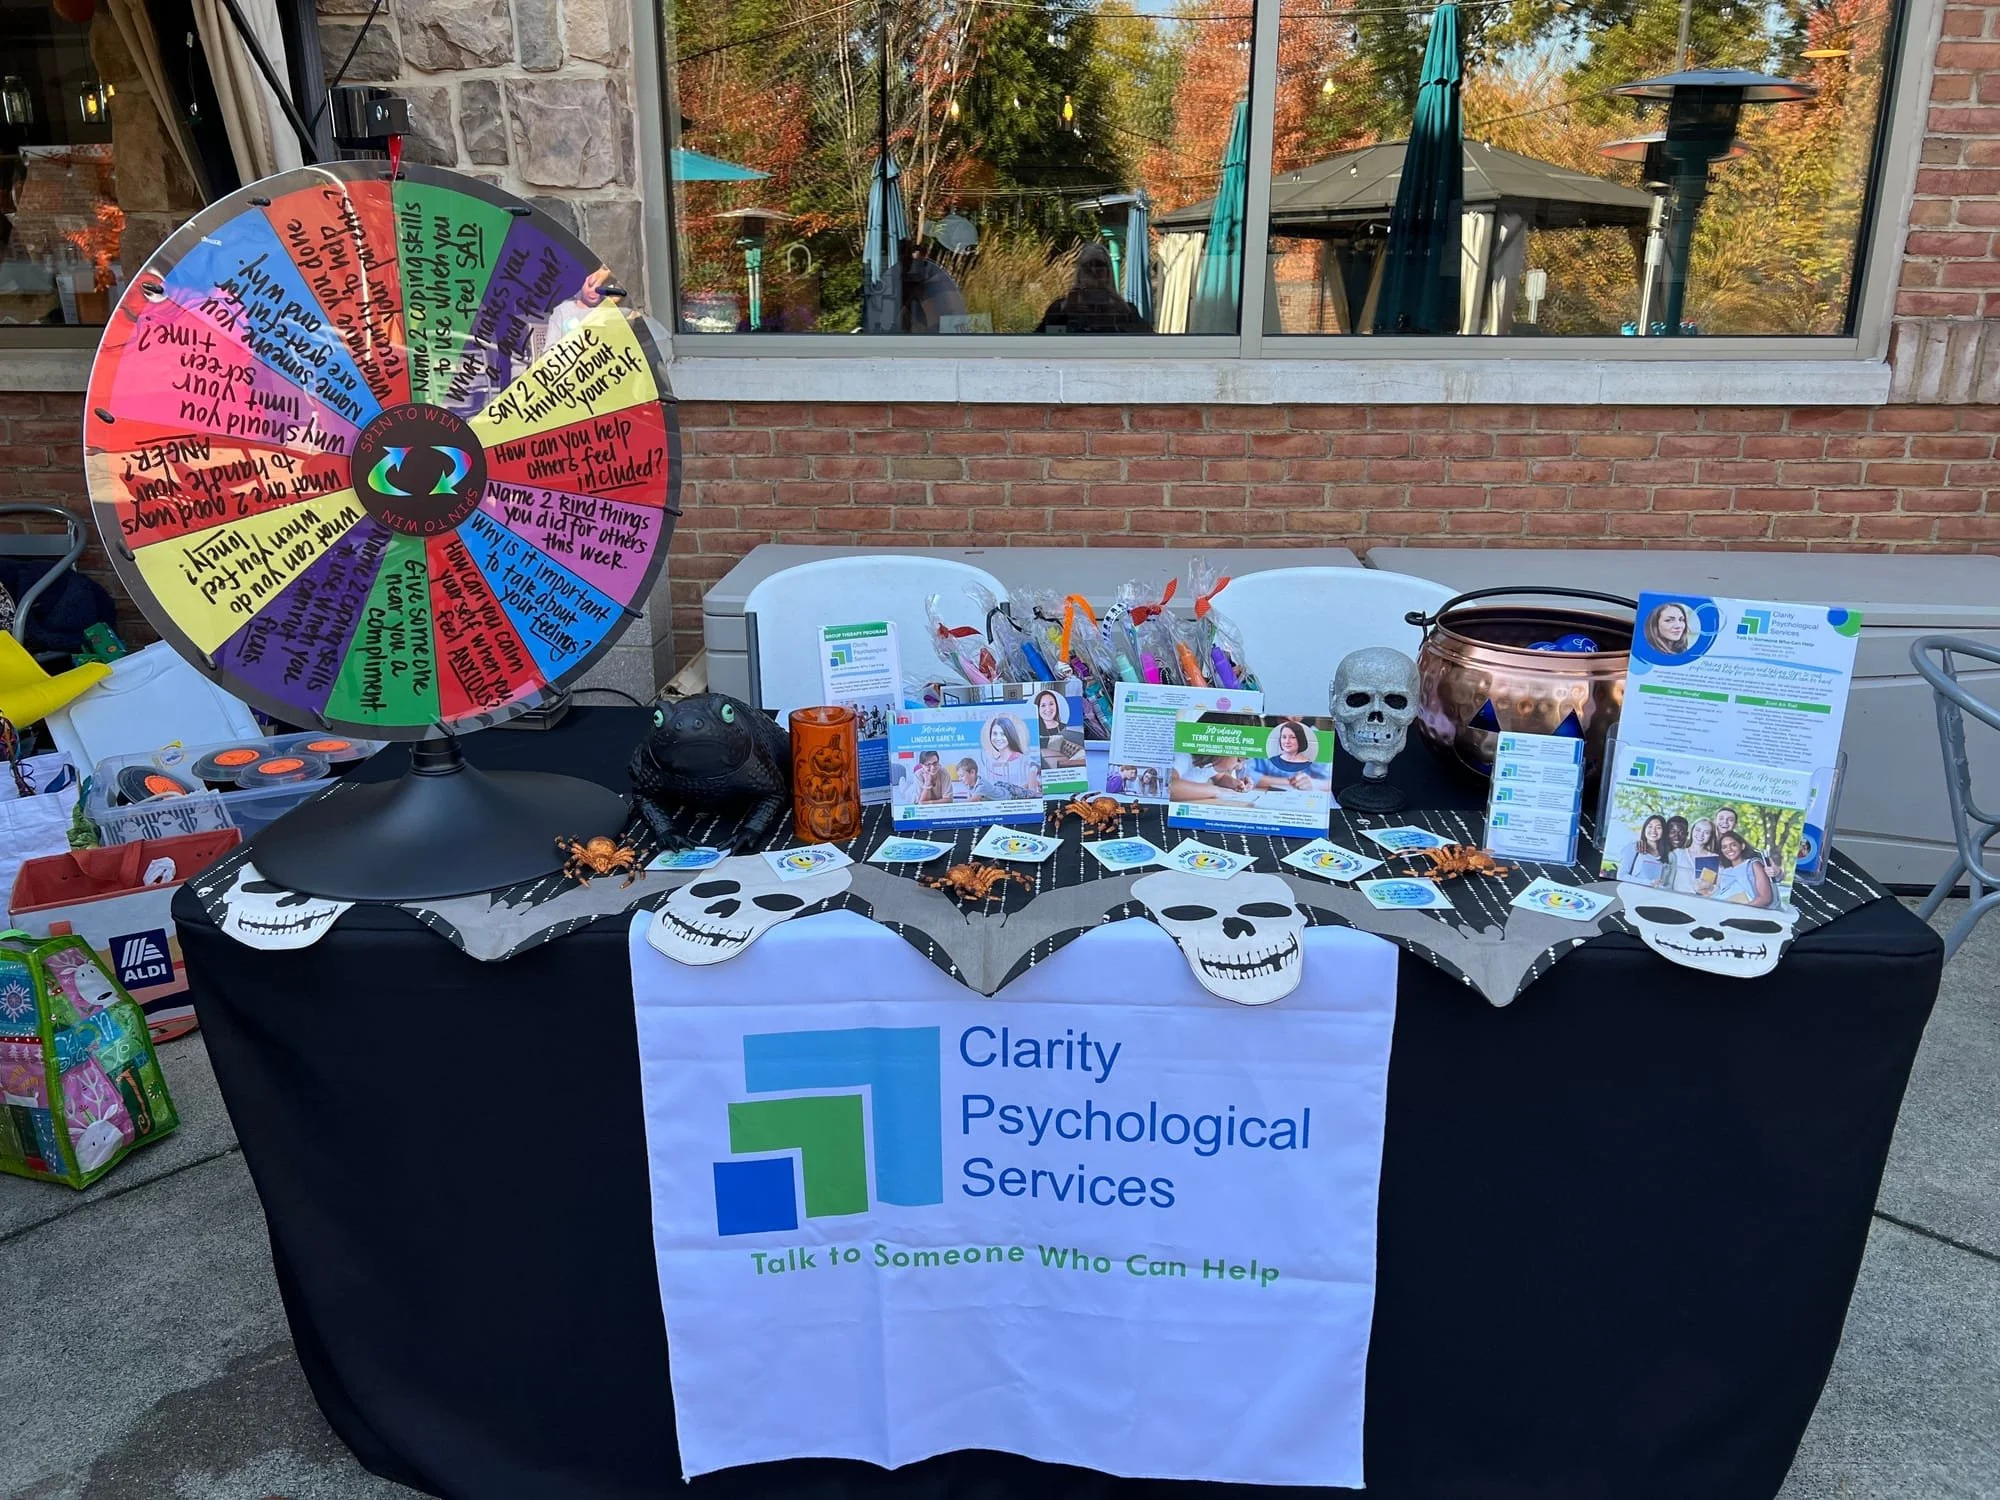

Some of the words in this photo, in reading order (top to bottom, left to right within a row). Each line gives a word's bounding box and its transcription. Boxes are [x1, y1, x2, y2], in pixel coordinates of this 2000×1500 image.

[288, 219, 323, 274] done
[320, 218, 364, 270] help
[433, 216, 462, 249] you
[455, 223, 482, 269] SAD.
[214, 278, 249, 306] for
[238, 254, 284, 304] why.
[313, 272, 344, 312] you
[343, 274, 361, 295] to
[426, 254, 452, 310] when
[200, 296, 236, 332] you
[281, 302, 322, 333] and
[366, 278, 405, 323] your
[456, 280, 477, 319] feel
[138, 316, 216, 353] time?
[247, 303, 333, 367] grateful
[408, 328, 427, 340] 2
[435, 316, 452, 349] use
[445, 353, 484, 402] What
[499, 248, 531, 283] you
[179, 351, 255, 385] screen
[241, 325, 314, 385] someone
[409, 344, 430, 391] Name
[433, 358, 450, 376] to
[172, 373, 237, 402] your
[328, 363, 356, 390] are
[489, 393, 523, 424] Say
[517, 381, 535, 402] 2
[532, 328, 599, 388] positive
[517, 381, 584, 423] things
[570, 343, 615, 383] about
[576, 347, 643, 415] yourself.
[179, 399, 221, 428] you
[246, 387, 300, 414] limit
[316, 371, 362, 424] Name
[227, 407, 300, 444] should
[361, 416, 393, 453] SPIN
[394, 407, 418, 420] TO
[424, 408, 460, 432] WIN
[493, 444, 525, 464] How
[531, 438, 558, 457] can
[559, 430, 592, 454] you
[594, 417, 631, 449] help
[271, 451, 295, 473] to
[527, 457, 578, 479] others
[582, 444, 616, 466] feel
[577, 448, 663, 489] included?
[136, 462, 182, 503] your
[253, 482, 286, 503] are
[291, 469, 343, 497] What
[231, 492, 248, 514] 2
[382, 510, 418, 532] WIN
[448, 488, 478, 523] SPIN
[487, 481, 535, 507] Name
[540, 492, 553, 509] 2
[600, 498, 650, 536] things
[268, 509, 321, 549] when
[315, 507, 365, 547] What
[425, 520, 447, 532] TO
[503, 505, 533, 527] you
[536, 506, 567, 532] did
[570, 515, 598, 539] for
[599, 527, 647, 553] others
[542, 533, 573, 553] this
[180, 520, 250, 585] lonely?
[227, 534, 274, 574] you
[282, 540, 315, 571] can
[472, 510, 504, 548] Why
[503, 540, 518, 556] is
[521, 551, 537, 567] it
[537, 559, 610, 624] important
[195, 566, 240, 605] feel
[250, 565, 286, 598] you
[385, 574, 403, 613] near
[404, 558, 427, 605] Give
[485, 552, 499, 572] to
[504, 565, 536, 603] talk
[535, 590, 577, 627] about
[494, 581, 537, 616] your
[230, 594, 254, 614] do
[444, 540, 470, 572] How
[461, 572, 487, 600] can
[475, 601, 502, 630] you
[495, 631, 523, 673] calm
[379, 622, 405, 654] you
[282, 638, 309, 684] you
[355, 607, 388, 715] compliment.
[391, 661, 408, 677] a
[436, 611, 458, 643] feel
[448, 641, 499, 709] ANXIOUS?
[471, 633, 500, 675] when
[490, 676, 513, 705] you
[124, 963, 167, 982] ALDI
[959, 1025, 1121, 1083] Clarity
[961, 1095, 1312, 1156] Psychological
[961, 1157, 1176, 1209] Services
[751, 1246, 818, 1276] Talk
[829, 1246, 861, 1267] to
[874, 1243, 1025, 1269] Someone
[1039, 1244, 1112, 1276] Who
[1125, 1253, 1186, 1278] Can
[1203, 1258, 1281, 1288] Help
